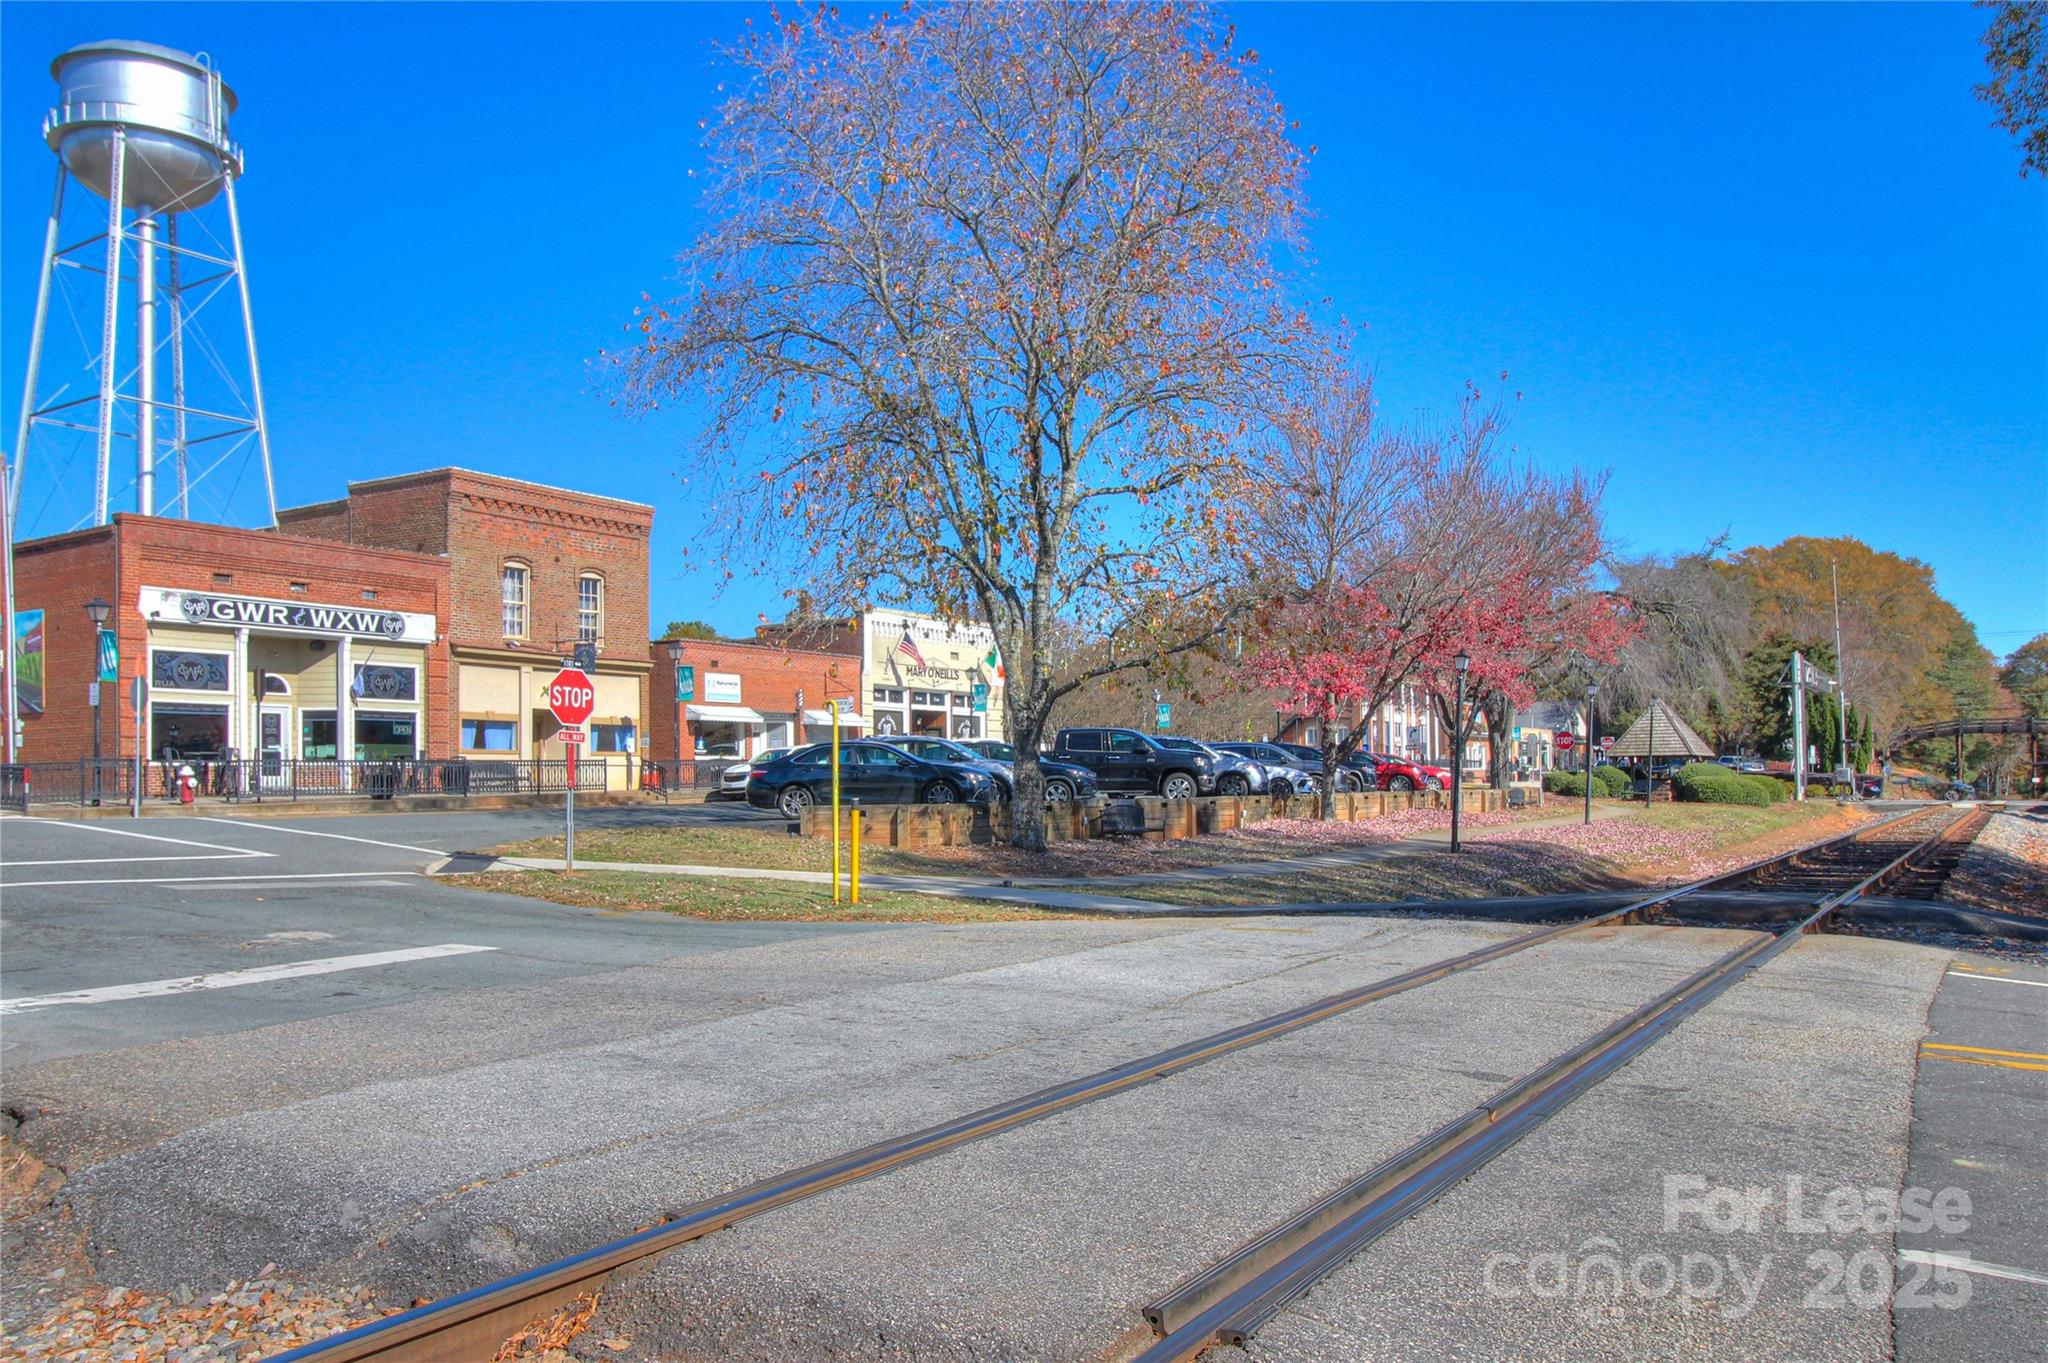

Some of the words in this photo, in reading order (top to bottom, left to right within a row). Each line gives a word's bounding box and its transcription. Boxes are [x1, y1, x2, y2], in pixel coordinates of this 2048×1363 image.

[212, 600, 288, 625] GWR
[309, 611, 381, 632] WXW
[552, 686, 592, 708] STOP
[560, 732, 570, 740] ALL
[572, 733, 584, 741] WAY
[1555, 736, 1573, 745] STOP
